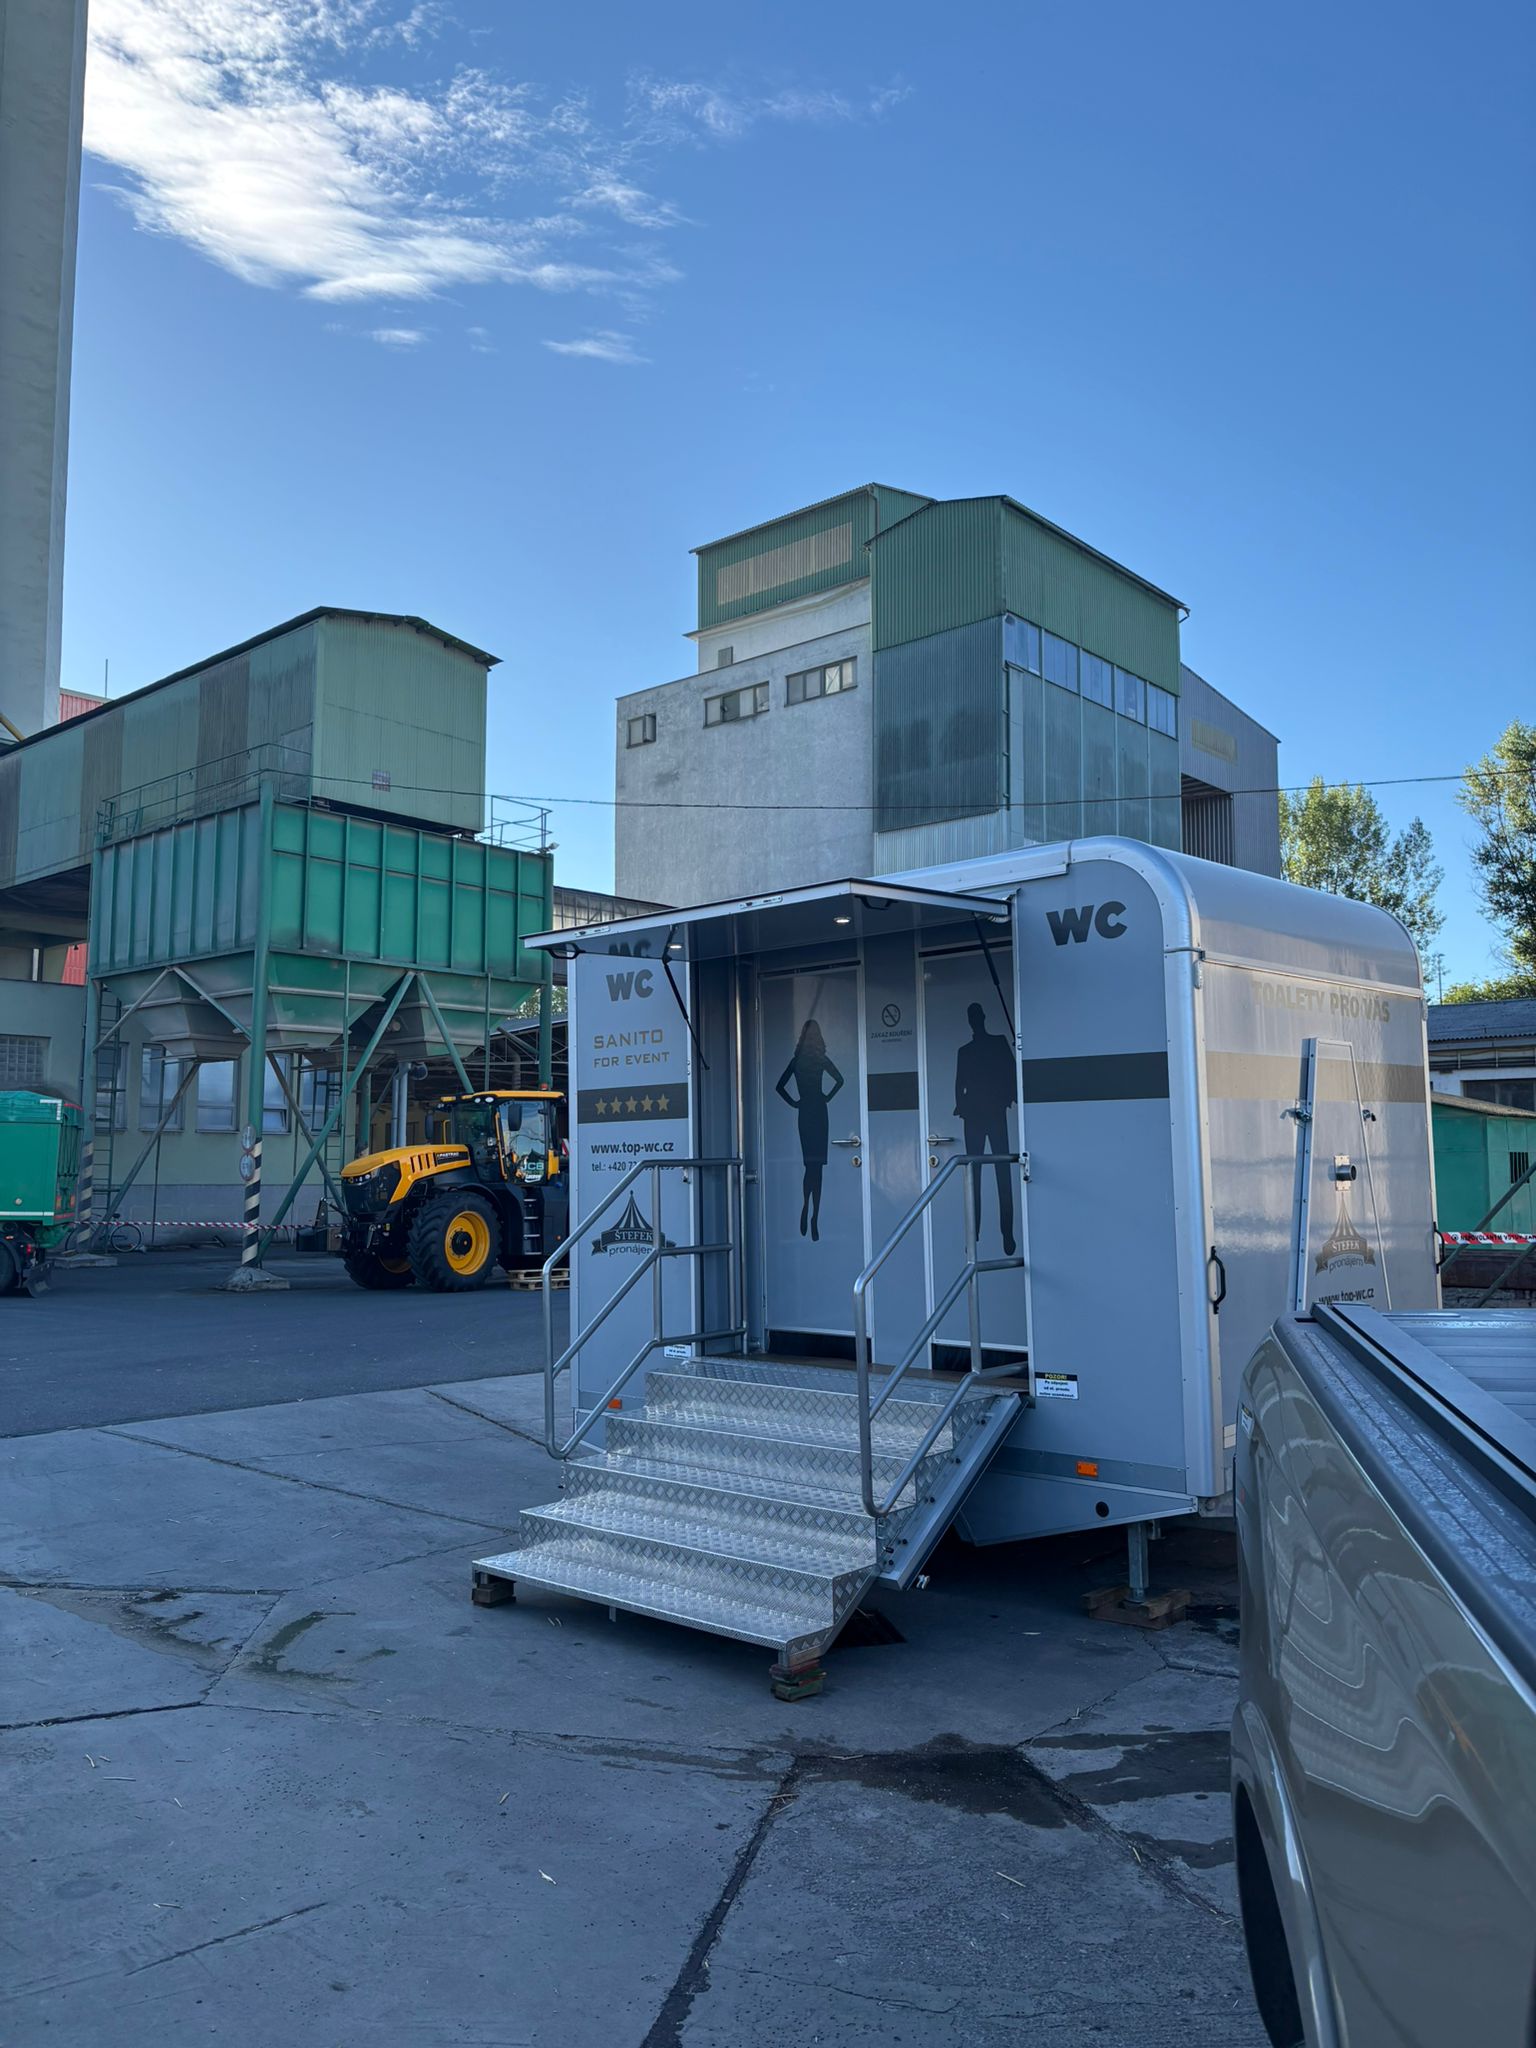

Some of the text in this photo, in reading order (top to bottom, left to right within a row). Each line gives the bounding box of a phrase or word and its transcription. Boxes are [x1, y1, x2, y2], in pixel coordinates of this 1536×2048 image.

[1046, 900, 1128, 946] WC
[605, 968, 654, 1002] WC
[1329, 992, 1360, 1018] PRO
[593, 1028, 664, 1049] SANITO
[593, 1051, 670, 1068] FOR EVENT
[591, 1141, 674, 1156] www.top-wc.cz
[521, 1162, 544, 1171] JCB
[607, 1161, 627, 1172] +420
[614, 1229, 653, 1241] ŠTEFEK
